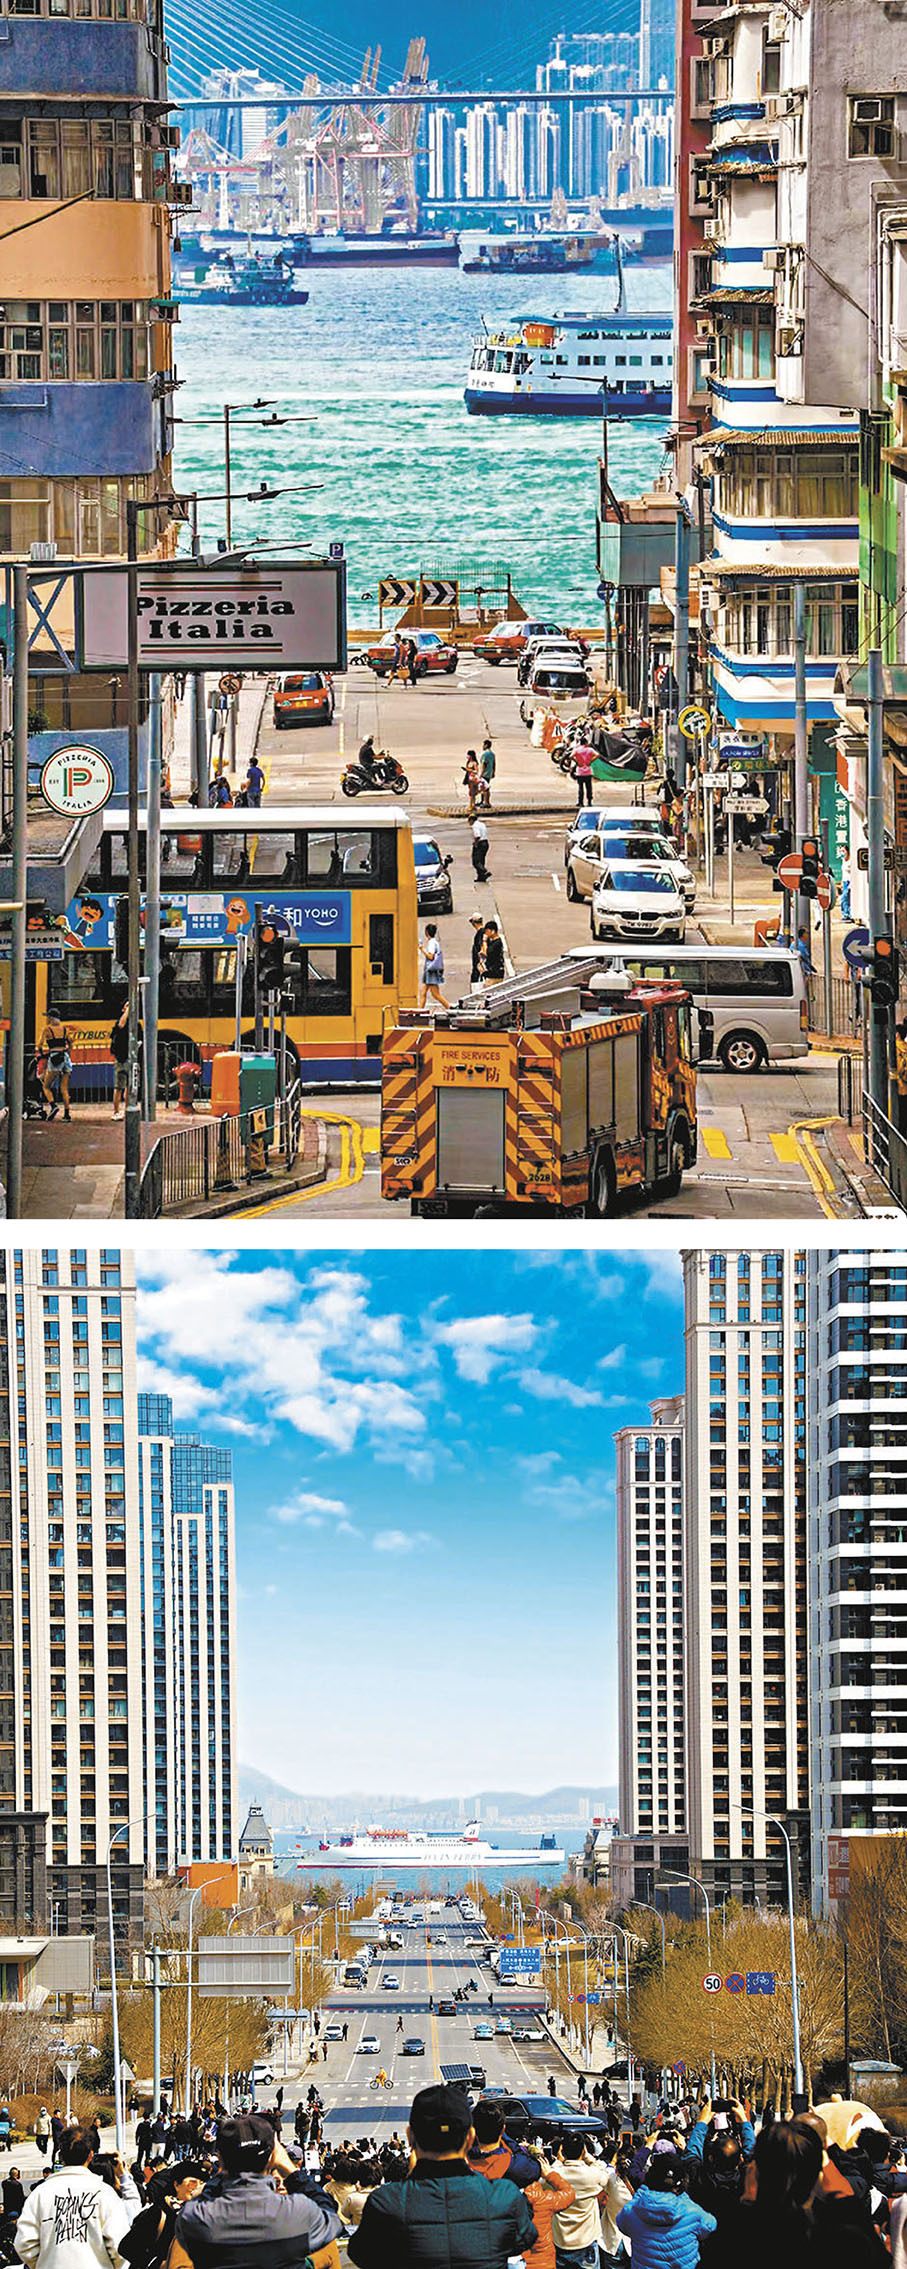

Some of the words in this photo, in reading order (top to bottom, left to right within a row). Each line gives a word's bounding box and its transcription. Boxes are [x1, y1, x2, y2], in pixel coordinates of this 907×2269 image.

[332, 544, 341, 556] P
[136, 595, 295, 616] Pizzeria
[149, 619, 273, 639] Italia
[57, 754, 97, 767] PIZZERIA
[62, 800, 92, 809] ITALIA
[304, 908, 338, 919] YOHO
[441, 1050, 459, 1060] FIRE
[461, 1050, 500, 1061] SERVICES
[529, 1173, 550, 1182] 2628
[705, 1978, 721, 1990] 50
